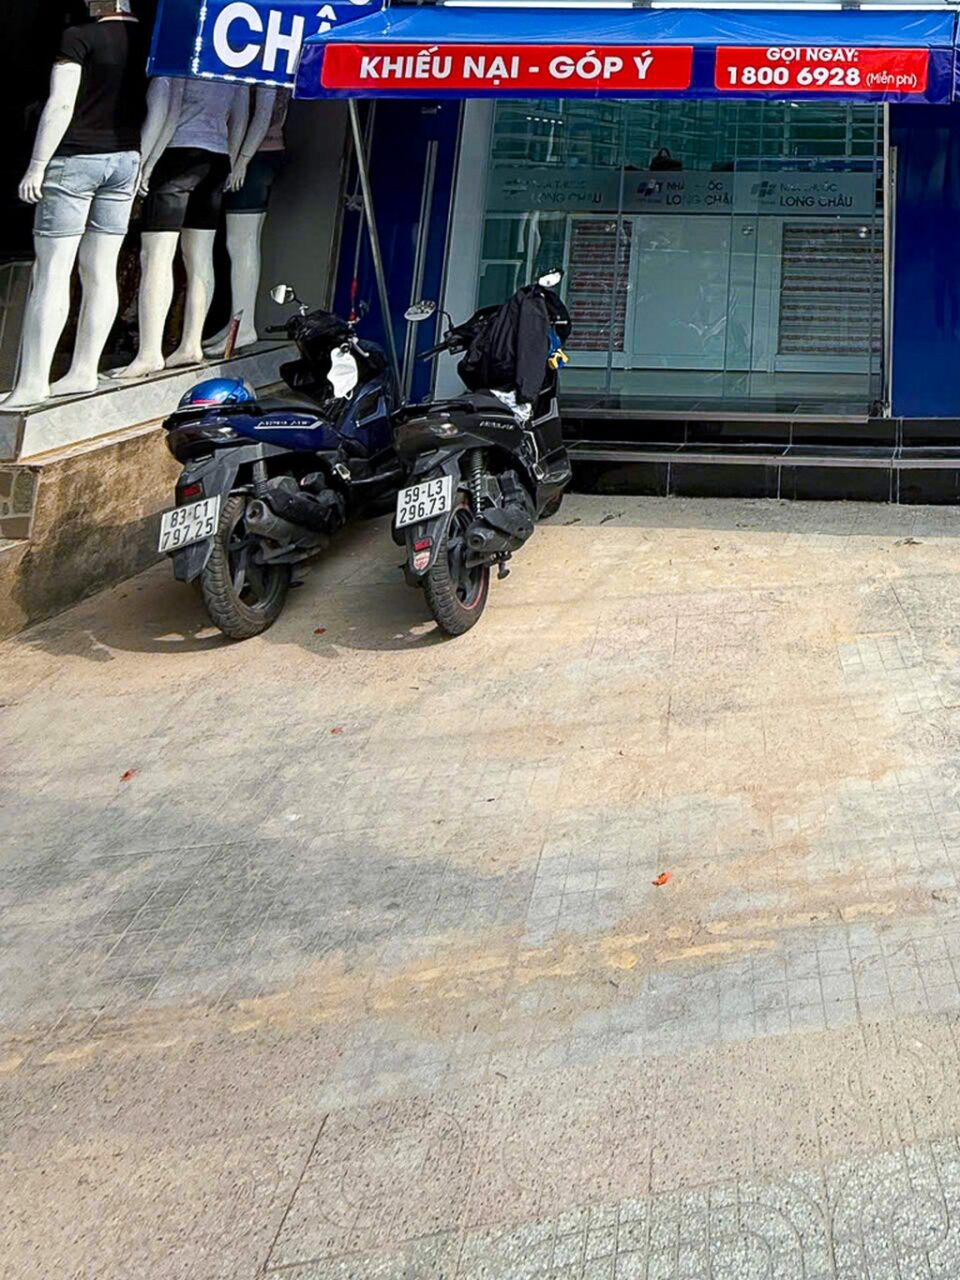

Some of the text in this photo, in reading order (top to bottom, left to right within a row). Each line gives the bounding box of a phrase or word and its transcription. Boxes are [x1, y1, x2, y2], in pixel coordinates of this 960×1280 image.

[359, 45, 452, 79] KHIẾU
[463, 55, 519, 85] NẠI
[548, 49, 623, 79] GÓP
[633, 49, 654, 79] Ý
[766, 47, 859, 64] GỌI NGAY:
[727, 66, 917, 88] 1800 6928 (Miễn phí)
[780, 195, 815, 207] LONG
[404, 479, 443, 505] 59-L3
[171, 501, 209, 528] 83-C1
[400, 495, 446, 524] 296.73
[161, 516, 213, 550] 797.25
